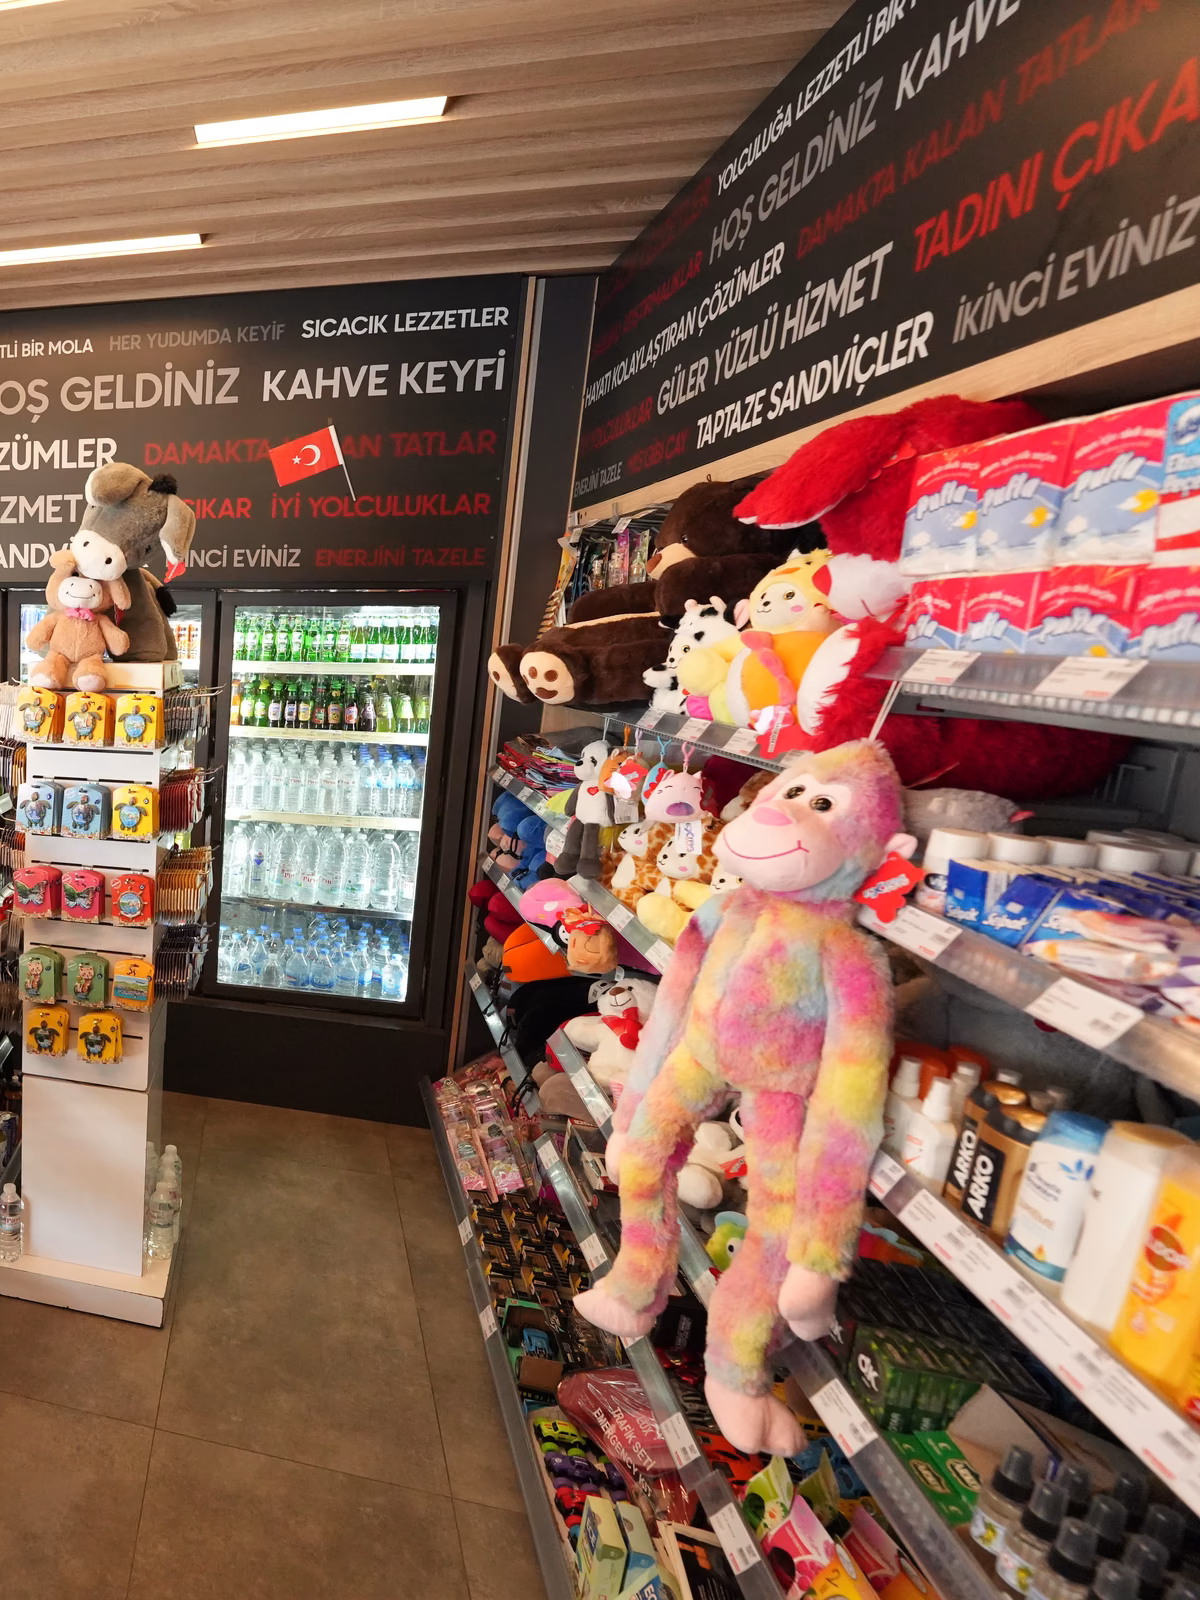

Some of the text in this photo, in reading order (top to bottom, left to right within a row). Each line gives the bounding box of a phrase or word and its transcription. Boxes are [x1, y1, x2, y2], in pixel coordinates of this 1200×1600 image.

[717, 103, 793, 196] YOLCULUĞA
[795, 14, 874, 121] LEZZETLİ
[708, 193, 755, 266] HOŞ
[757, 75, 885, 223] GELDİNİZ
[610, 305, 698, 390] KOLAYLAŞTIRAN
[697, 241, 786, 337] ÇÖZÜMLER
[796, 161, 897, 260] DAMAKTA
[902, 78, 1007, 186] KALAN
[656, 356, 710, 416] GÜLER
[713, 301, 780, 387] YÜZLÜ
[779, 240, 894, 351] HİZMET
[913, 150, 1045, 274] TADINI
[21, 338, 46, 358] BİR
[47, 338, 94, 356] MOLA
[109, 333, 142, 352] HER
[145, 328, 232, 350] YUDUMDA
[236, 320, 287, 344] KEYİF
[300, 313, 388, 339] SICACIK
[393, 306, 511, 333] LEZZETLER
[598, 460, 623, 489] TAZELE
[695, 387, 768, 451] TAPTAZE
[766, 310, 935, 422] SANDVİÇLER
[951, 252, 1057, 345] İKİNCİ
[1056, 194, 1200, 302] EVİNİZ
[60, 359, 240, 413] GELDİNİZ
[261, 362, 390, 403] KAHVE
[398, 348, 507, 396] KEYFİ
[144, 438, 273, 467] DAMAKTA
[389, 429, 499, 459] TATLAR
[270, 491, 302, 520] İYİ
[307, 492, 493, 519] YOLCULUKLAR
[232, 543, 302, 569] EVİNİZ
[314, 546, 406, 569] ENERJİNİ
[411, 546, 487, 568] TAZELE
[952, 1129, 978, 1190] ARKO
[966, 1154, 995, 1220] ARKO
[592, 1406, 639, 1477] EMERGENCY
[611, 1405, 658, 1473] TRAFİK SETİ
